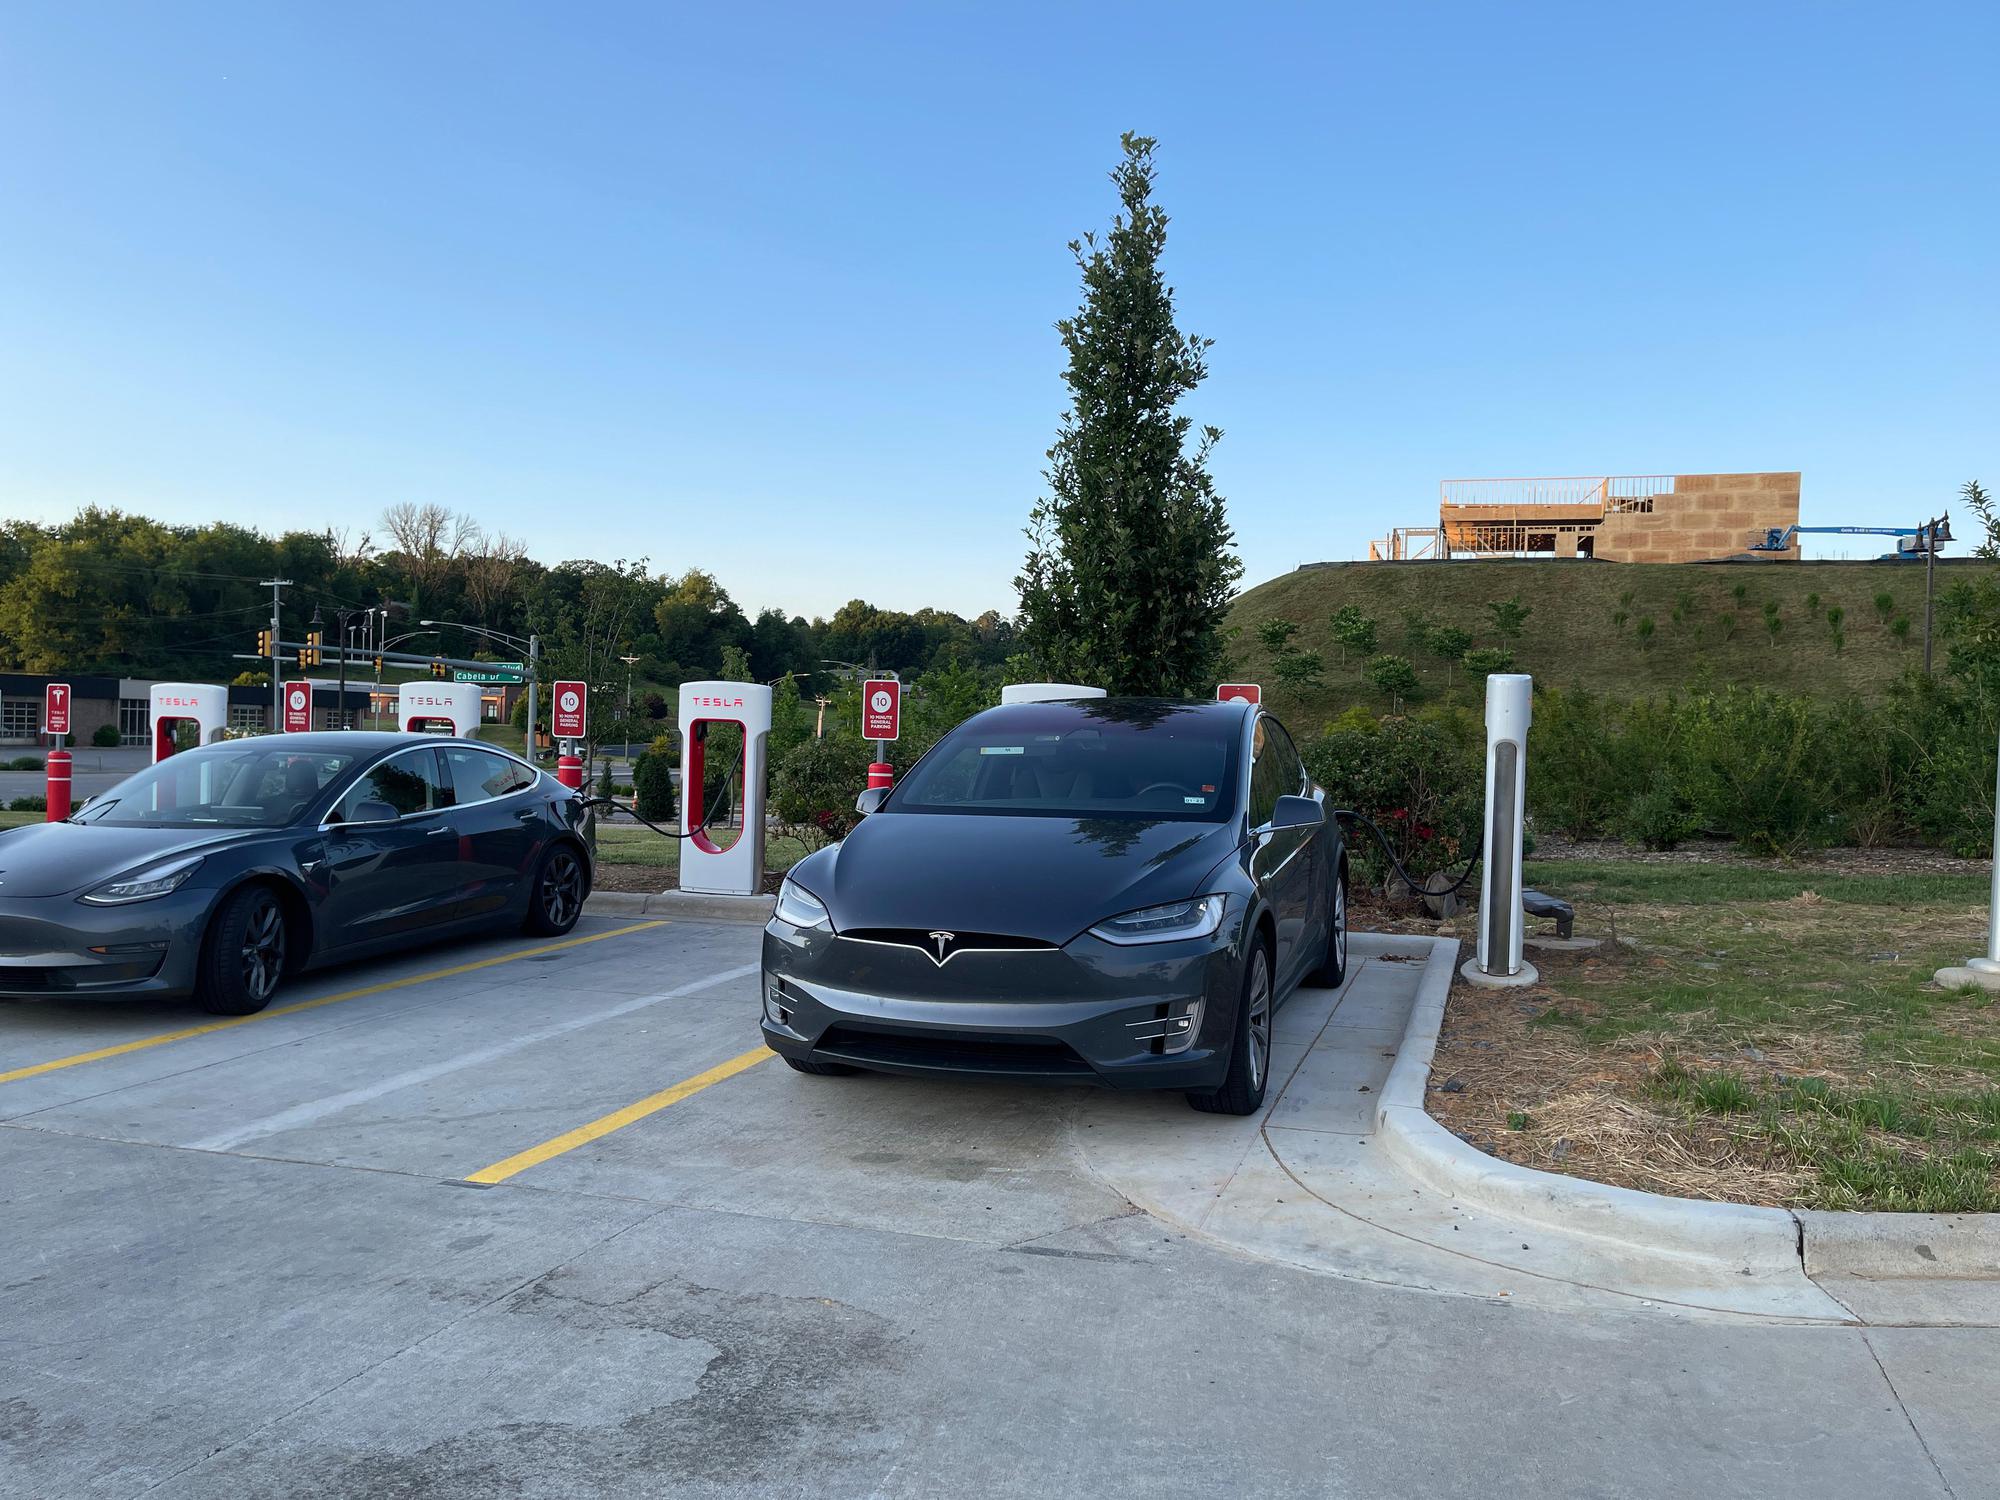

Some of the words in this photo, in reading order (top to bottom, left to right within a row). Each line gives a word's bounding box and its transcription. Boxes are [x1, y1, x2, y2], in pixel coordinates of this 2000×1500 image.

[456, 672, 486, 680] Cabela
[159, 697, 198, 706] TESLA
[294, 696, 303, 705] 10
[409, 697, 453, 706] TESLA
[565, 697, 575, 706] 10
[692, 697, 743, 707] TESLA
[876, 697, 888, 706] 10
